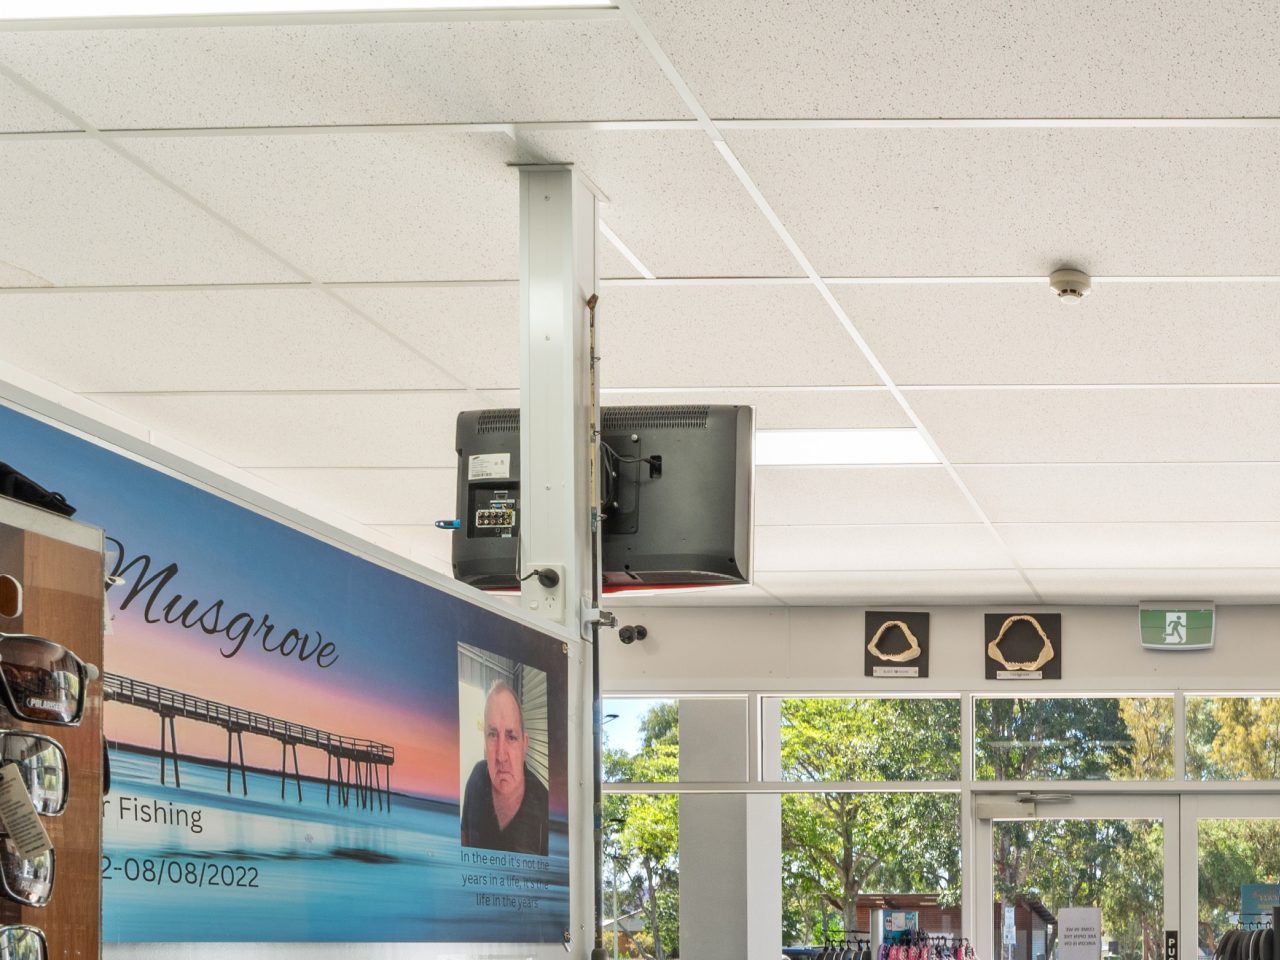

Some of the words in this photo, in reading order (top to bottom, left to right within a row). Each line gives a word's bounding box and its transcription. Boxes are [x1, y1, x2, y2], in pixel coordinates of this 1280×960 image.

[104, 535, 339, 668] Musgrove
[119, 796, 203, 834] Fishing
[102, 855, 260, 888] 2-08/08/2022
[460, 850, 470, 863] In
[472, 851, 488, 865] the
[489, 855, 507, 867] end
[508, 856, 521, 868] it's
[522, 859, 536, 870] not
[537, 859, 550, 871] the
[461, 873, 488, 887] years
[489, 874, 498, 885] in
[500, 878, 505, 887] a
[506, 875, 522, 889] life,
[476, 893, 491, 906] life
[492, 894, 501, 907] in
[503, 894, 516, 908] the
[517, 899, 539, 911] years
